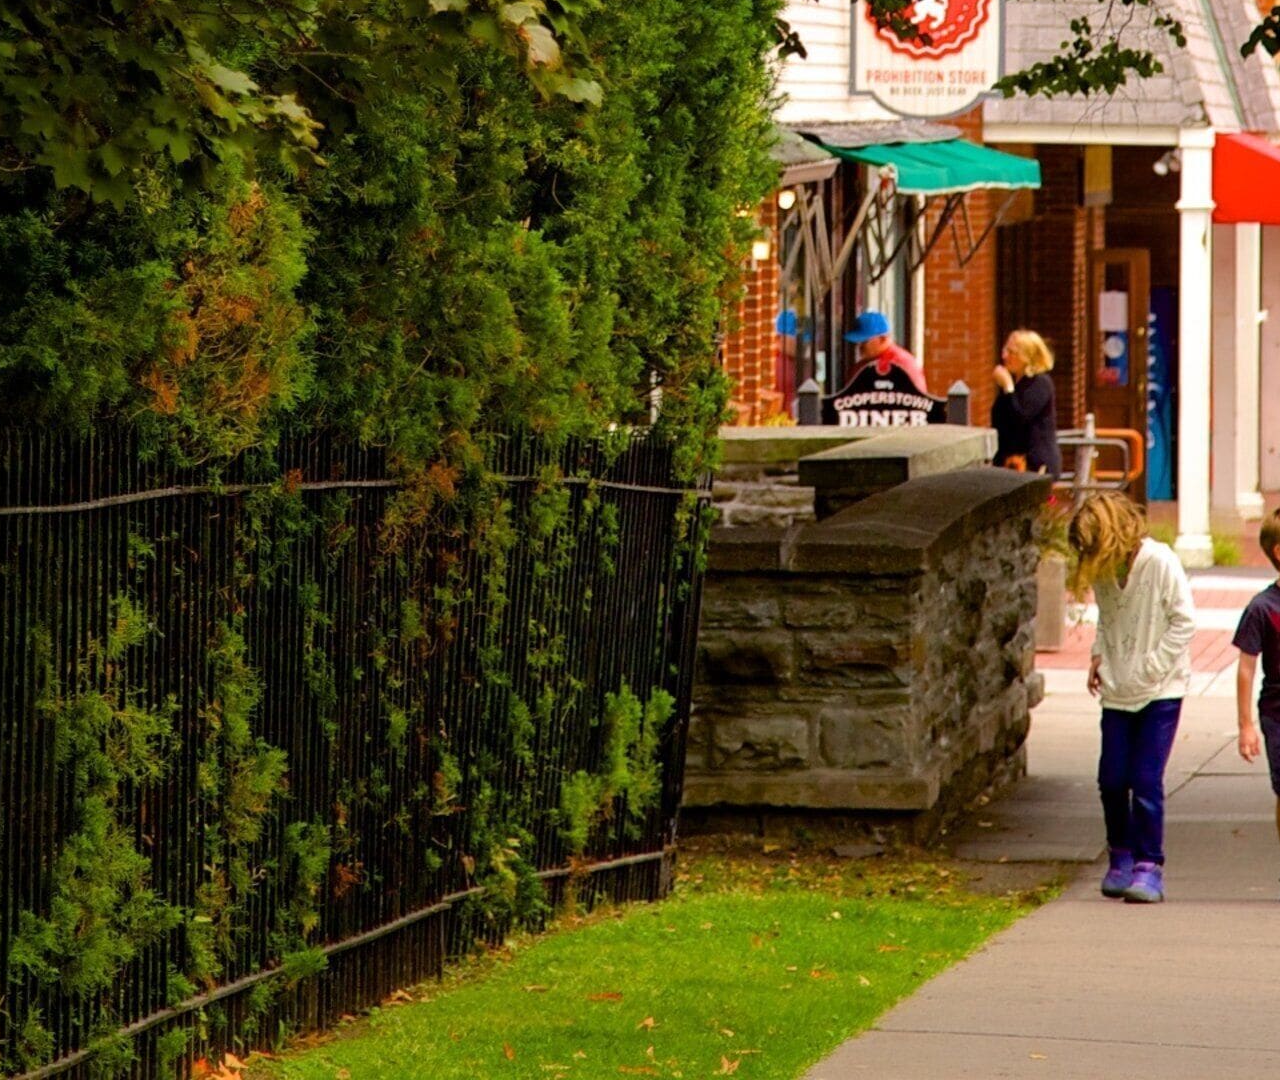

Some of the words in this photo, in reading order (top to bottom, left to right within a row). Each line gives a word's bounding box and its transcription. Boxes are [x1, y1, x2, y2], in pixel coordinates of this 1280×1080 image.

[866, 70, 944, 84] PROHIBITION
[949, 70, 986, 84] STORE
[834, 392, 933, 412] COOPERSTOWN
[839, 410, 928, 427] DINER
